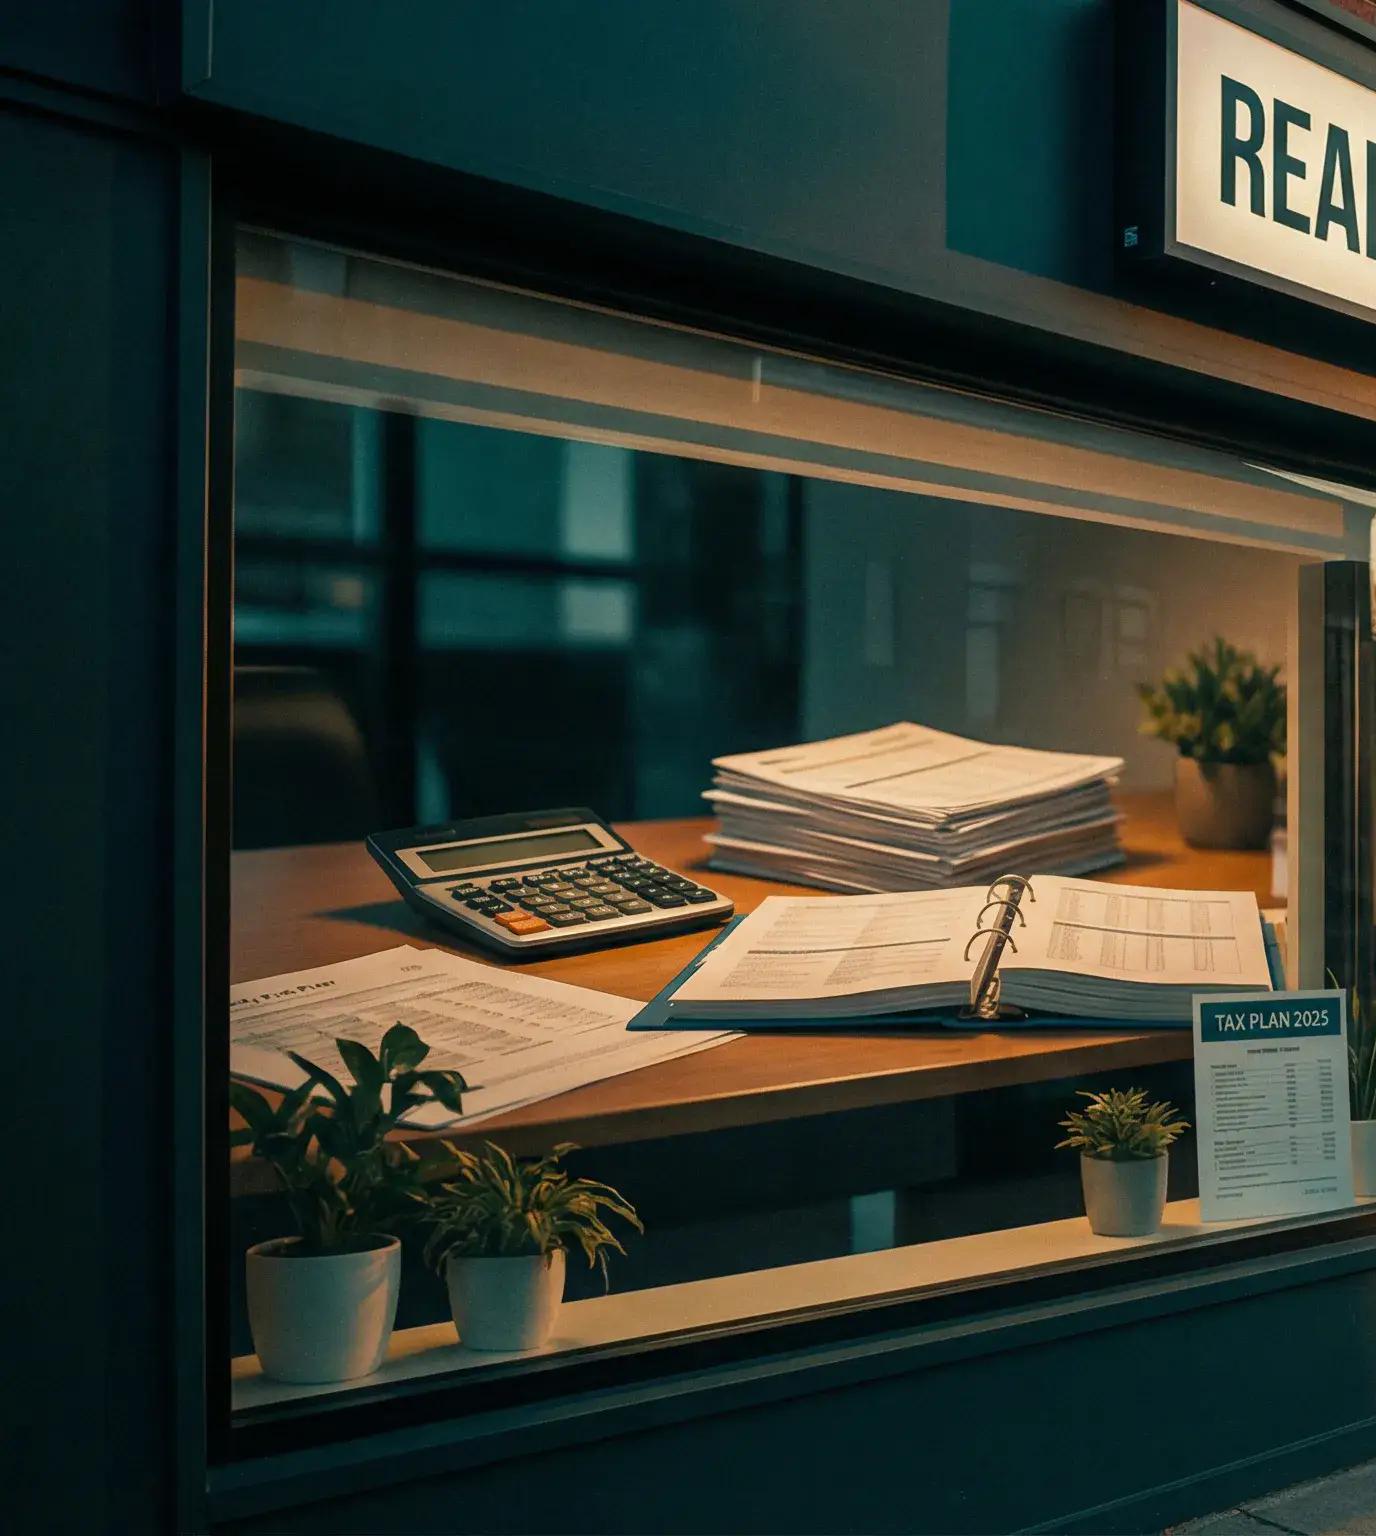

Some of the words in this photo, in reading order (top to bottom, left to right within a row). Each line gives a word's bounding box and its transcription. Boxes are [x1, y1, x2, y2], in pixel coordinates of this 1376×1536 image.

[1214, 1013, 1246, 1032] TAX
[1249, 1011, 1290, 1030] PLAN
[1293, 1009, 1329, 1028] 2025
